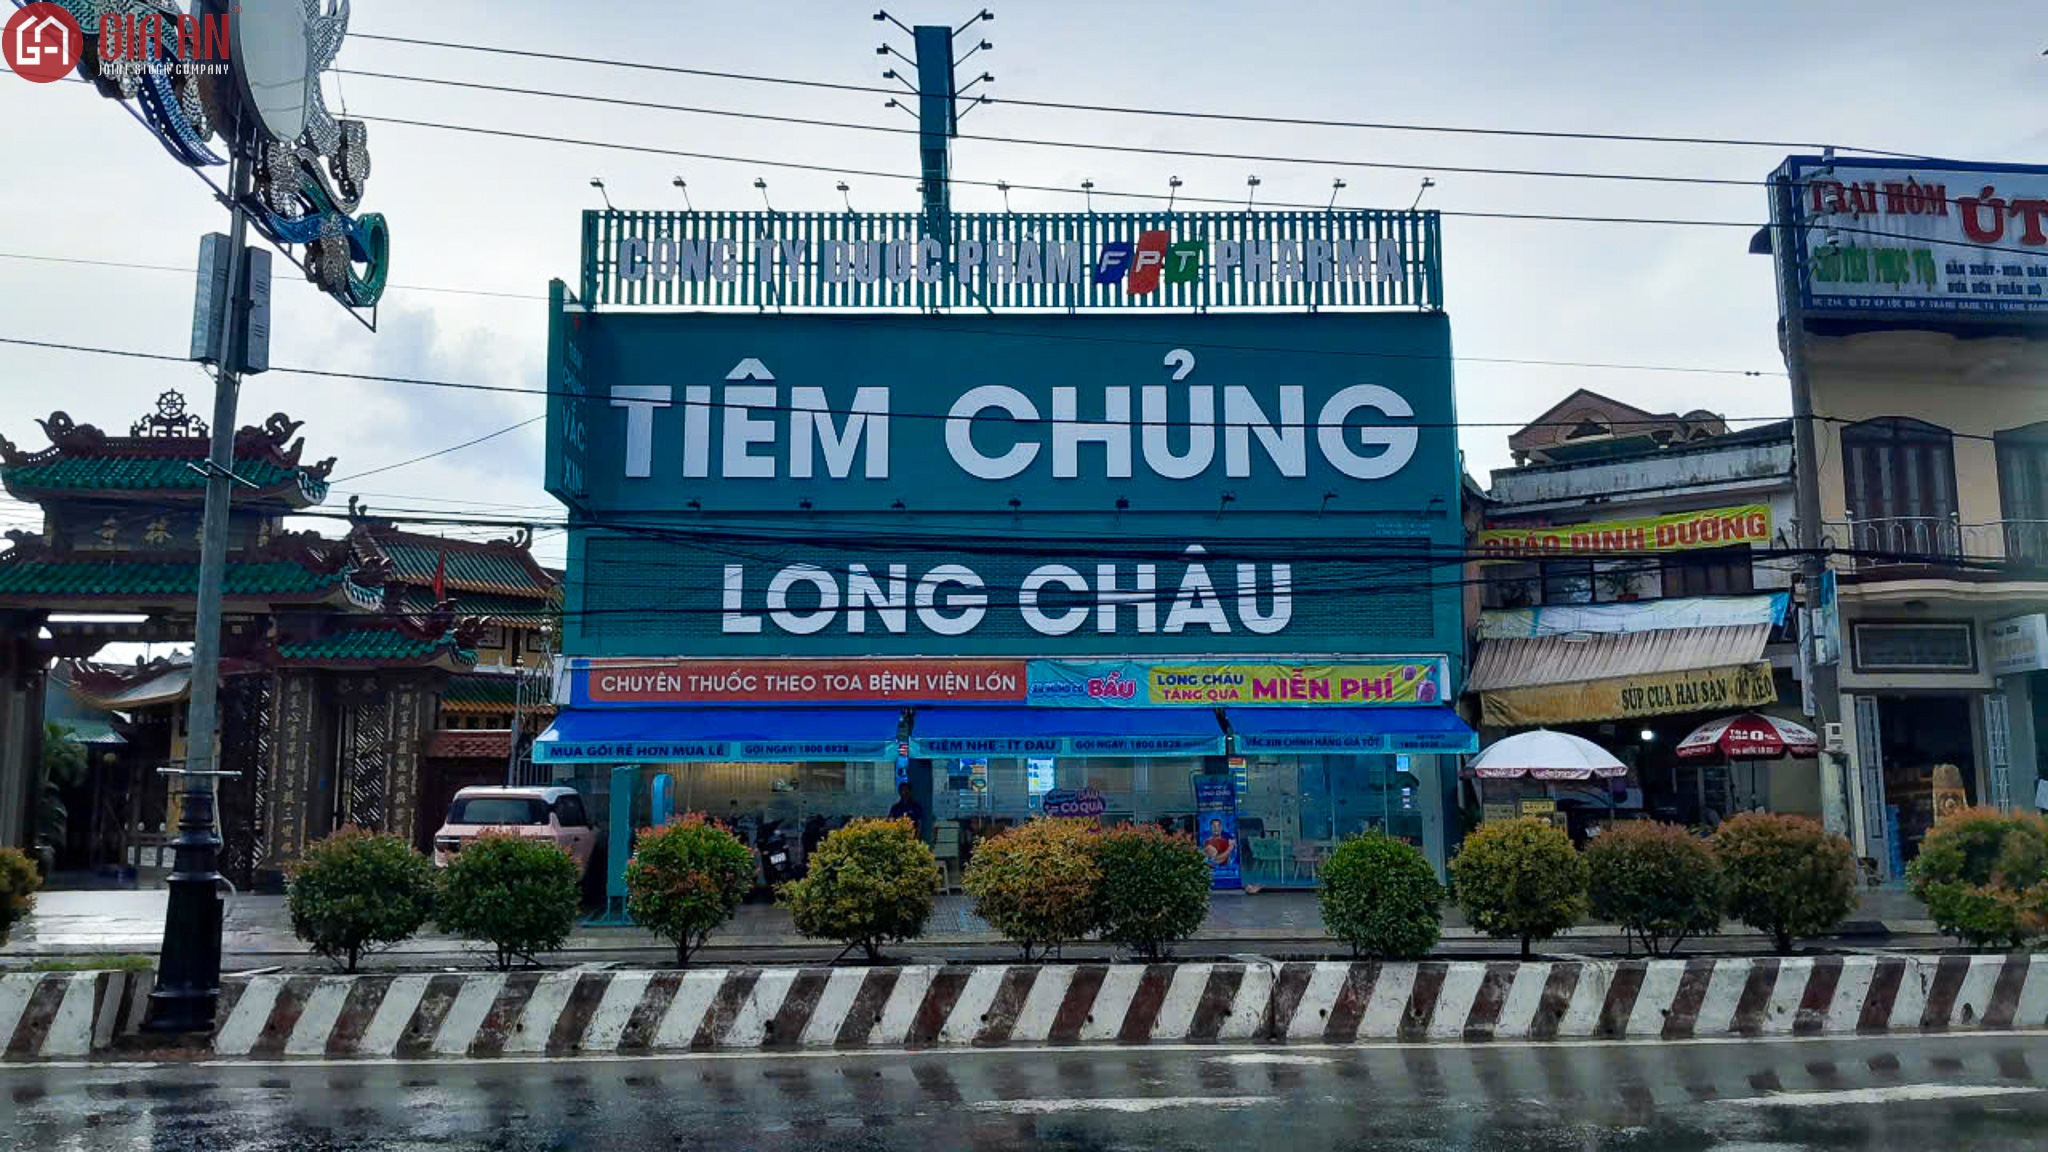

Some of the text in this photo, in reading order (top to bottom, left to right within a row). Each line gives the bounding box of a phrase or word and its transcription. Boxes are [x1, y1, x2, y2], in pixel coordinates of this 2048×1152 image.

[619, 229, 737, 283] CÔNG
[755, 238, 806, 282] TY
[1215, 238, 1403, 282] PHARMA
[610, 349, 1418, 479] TIÊM CHỦNG
[1571, 528, 1645, 552] DINH
[722, 543, 1292, 634] LONG CHÂU
[601, 669, 1016, 695] CHUYÊN THUỐC THEO TOA BỆNH VIỆN LỚN
[1157, 671, 1243, 686] LONG CHÂU
[1253, 667, 1394, 699] MIỄN PHÍ
[1622, 681, 1644, 710] SÚP
[1648, 682, 1674, 707] CUA
[1675, 672, 1698, 704] HẢI
[1701, 670, 1727, 701] SẢN
[550, 745, 583, 755] MUA
[587, 743, 612, 755] GÓI
[616, 741, 632, 755] RẺ
[637, 744, 668, 754] HƠN
[672, 744, 705, 754] MUA
[928, 740, 962, 751] TIÊM
[1025, 740, 1056, 751] ĐAU
